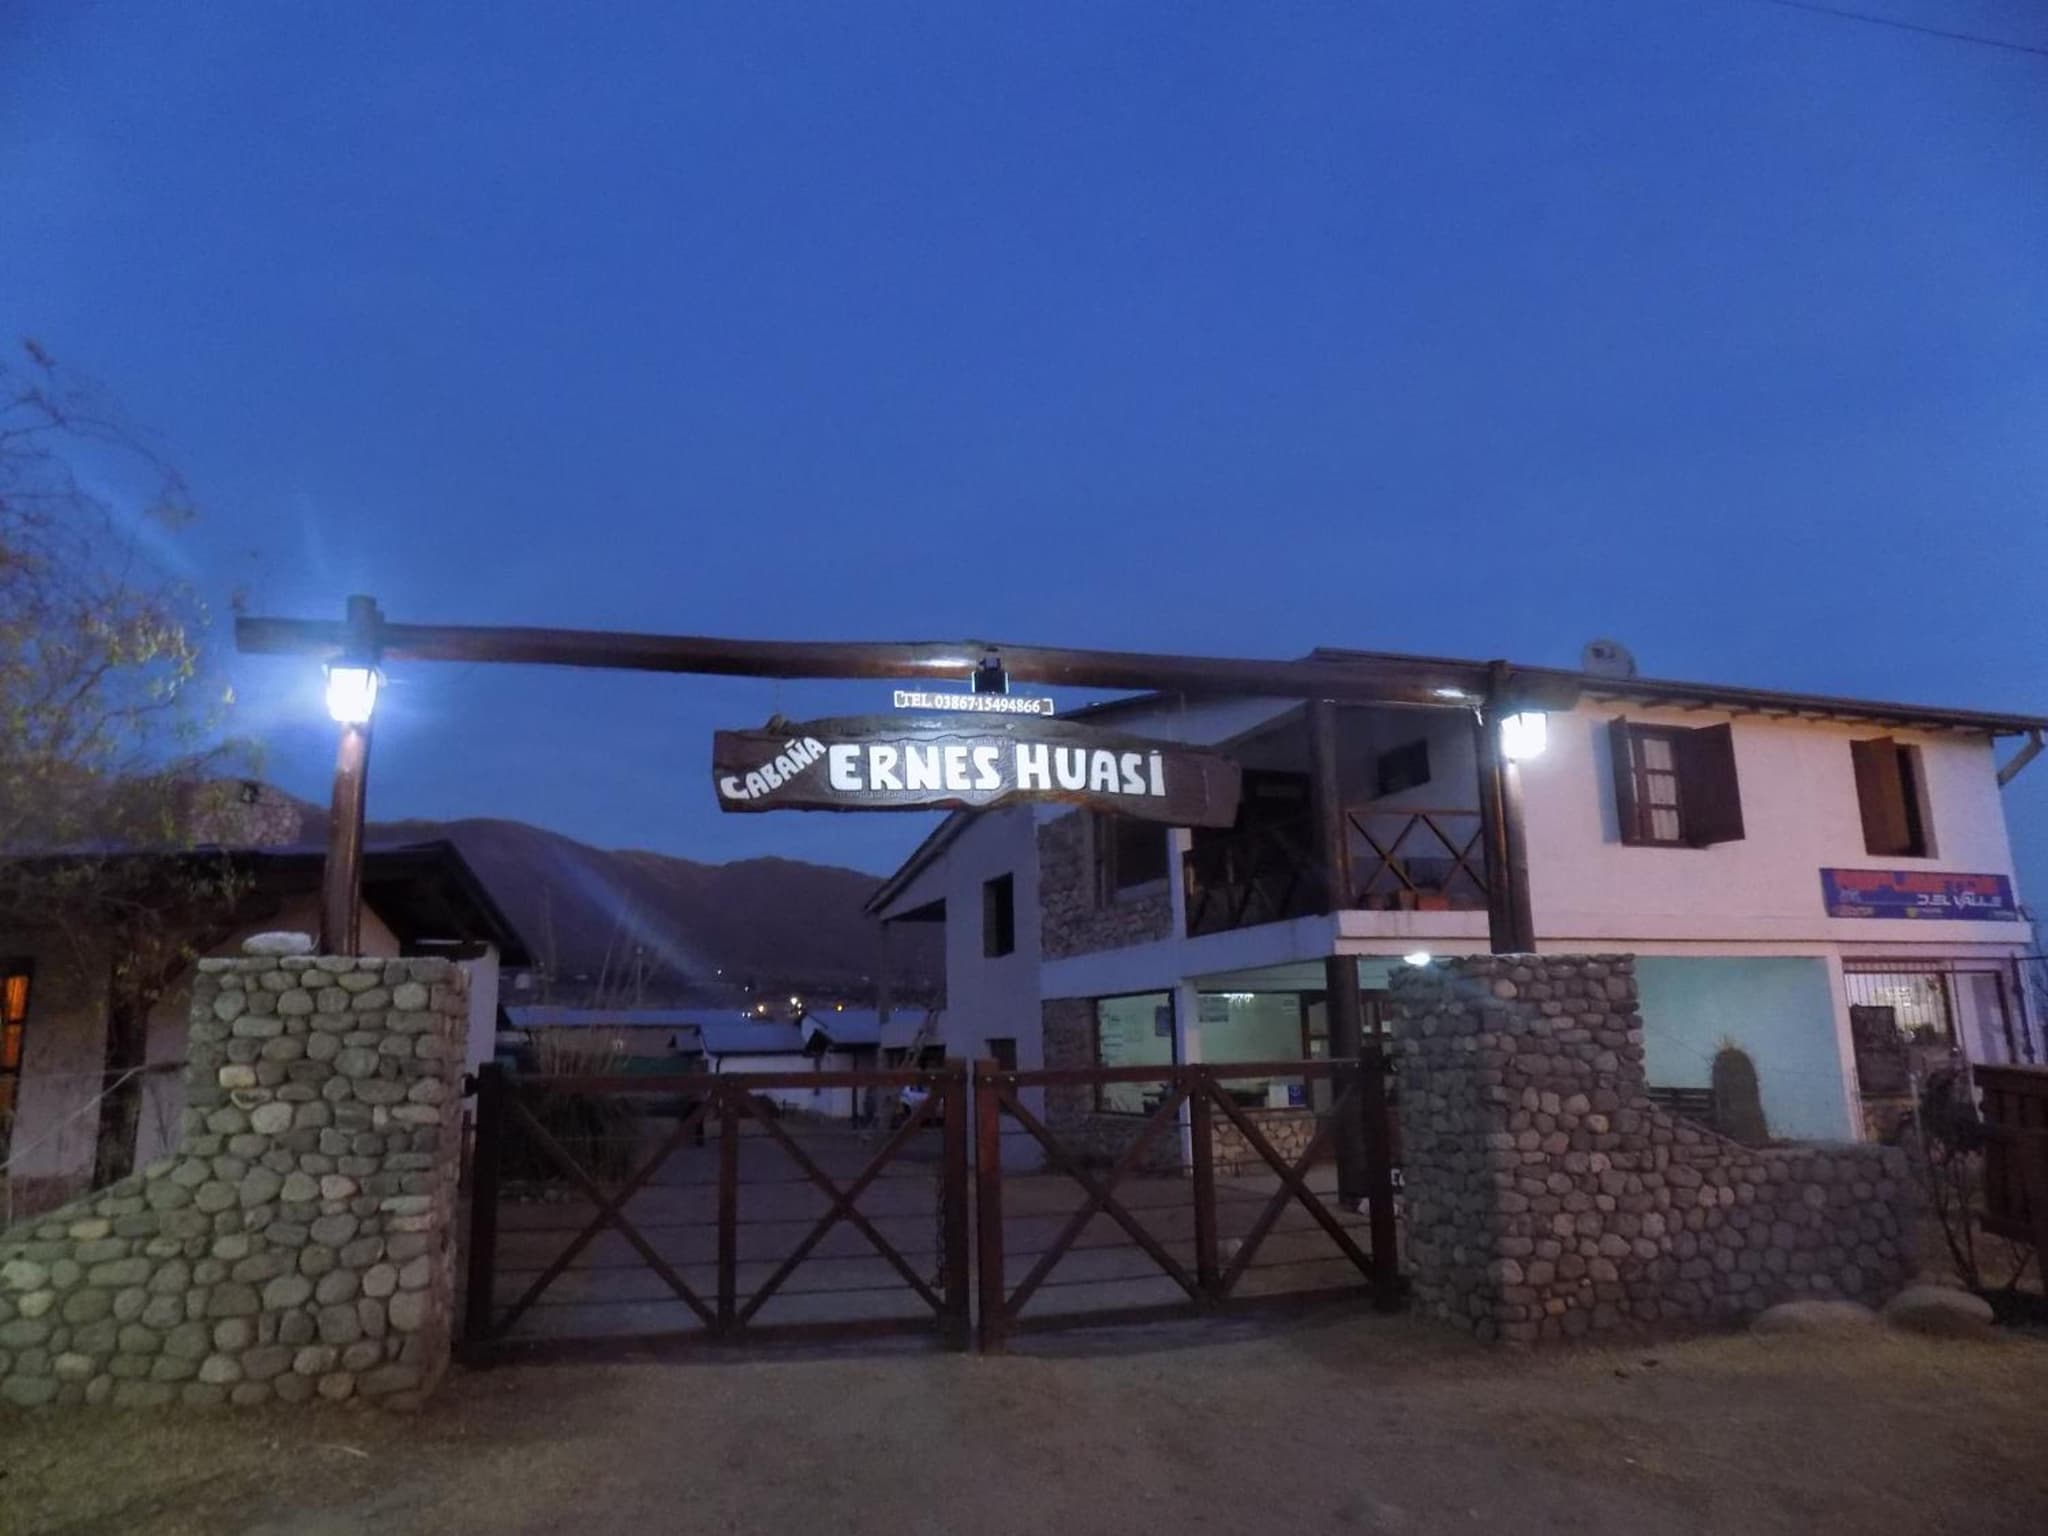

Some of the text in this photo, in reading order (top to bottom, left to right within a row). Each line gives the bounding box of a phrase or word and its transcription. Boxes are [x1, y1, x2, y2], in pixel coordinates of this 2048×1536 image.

[720, 737, 827, 800] CABAÑA
[828, 743, 1165, 796] ERNES HUASI
